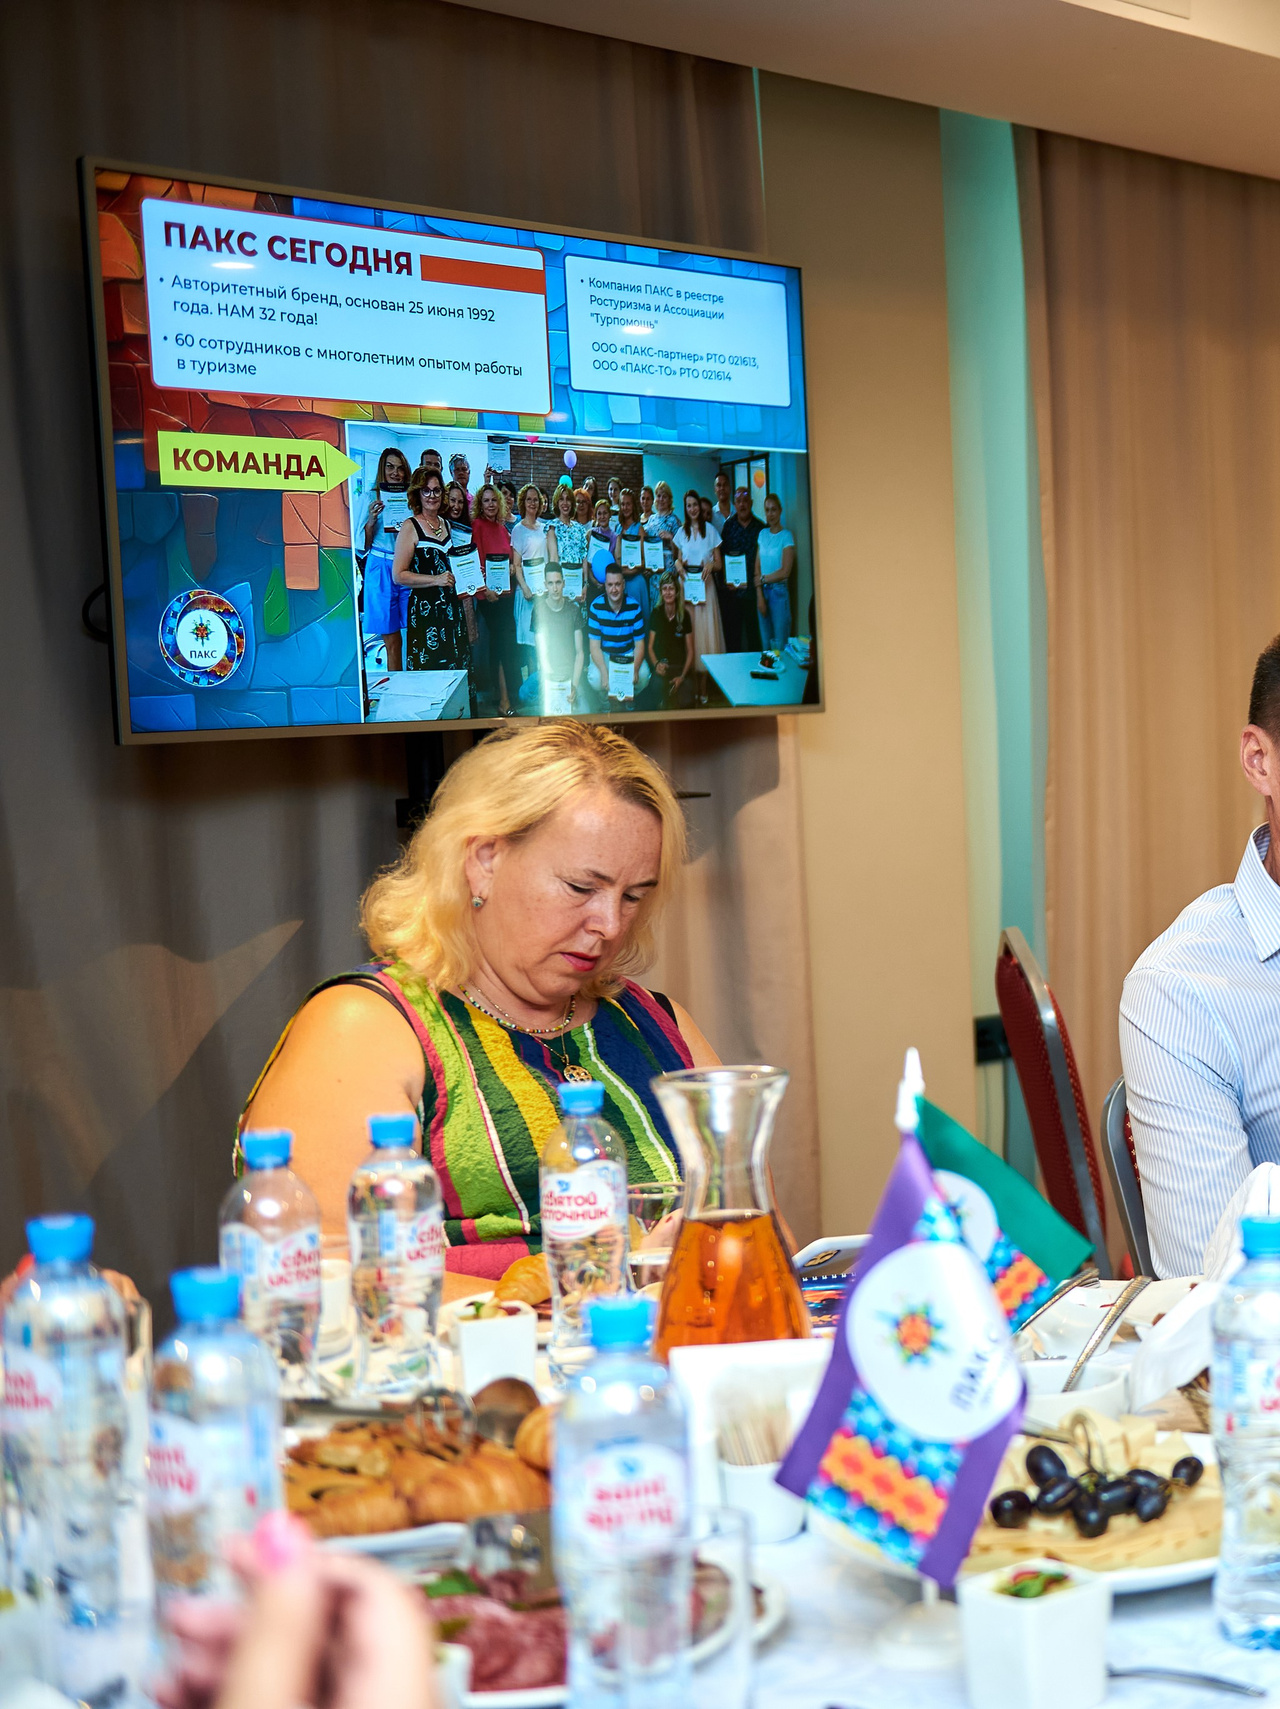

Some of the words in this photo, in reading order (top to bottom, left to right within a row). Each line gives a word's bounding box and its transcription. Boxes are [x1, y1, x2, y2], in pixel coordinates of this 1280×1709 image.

[164, 220, 258, 258] ПАКС
[267, 234, 412, 276] СЕГОДНЯ
[171, 275, 287, 300] Авторитетный
[291, 286, 342, 308] бренд,
[345, 296, 405, 313] основан
[408, 301, 424, 314] 25
[427, 305, 464, 319] июня
[467, 307, 496, 322] 1992
[589, 277, 642, 294] Компания
[645, 284, 673, 297] ПАКС
[676, 289, 682, 298] в
[684, 291, 724, 305] реестре
[173, 300, 213, 317] года.
[218, 304, 254, 320] НАМ
[259, 307, 276, 321] 32
[280, 310, 318, 327] года!
[590, 294, 651, 312] Ростуризма
[654, 304, 661, 312] и
[663, 306, 725, 320] Ассоциации
[175, 333, 194, 348] 60
[199, 336, 301, 357] сотрудников
[305, 346, 313, 358] с
[317, 347, 415, 368] многолетним
[418, 357, 471, 372] опытом
[474, 361, 523, 376] работы
[177, 358, 185, 370] в
[190, 359, 257, 376] туризме
[592, 342, 617, 354] ООО
[619, 344, 704, 364] «ПАКС-партнер»
[706, 353, 726, 364] РТО
[728, 355, 759, 369] 021613,
[592, 359, 618, 371] ООО
[620, 362, 677, 377] «ПАКС-ТО»
[679, 368, 699, 379] РТО
[701, 370, 732, 381] 021614
[172, 447, 326, 481] КОМАНДА
[189, 650, 217, 659] ПАКС
